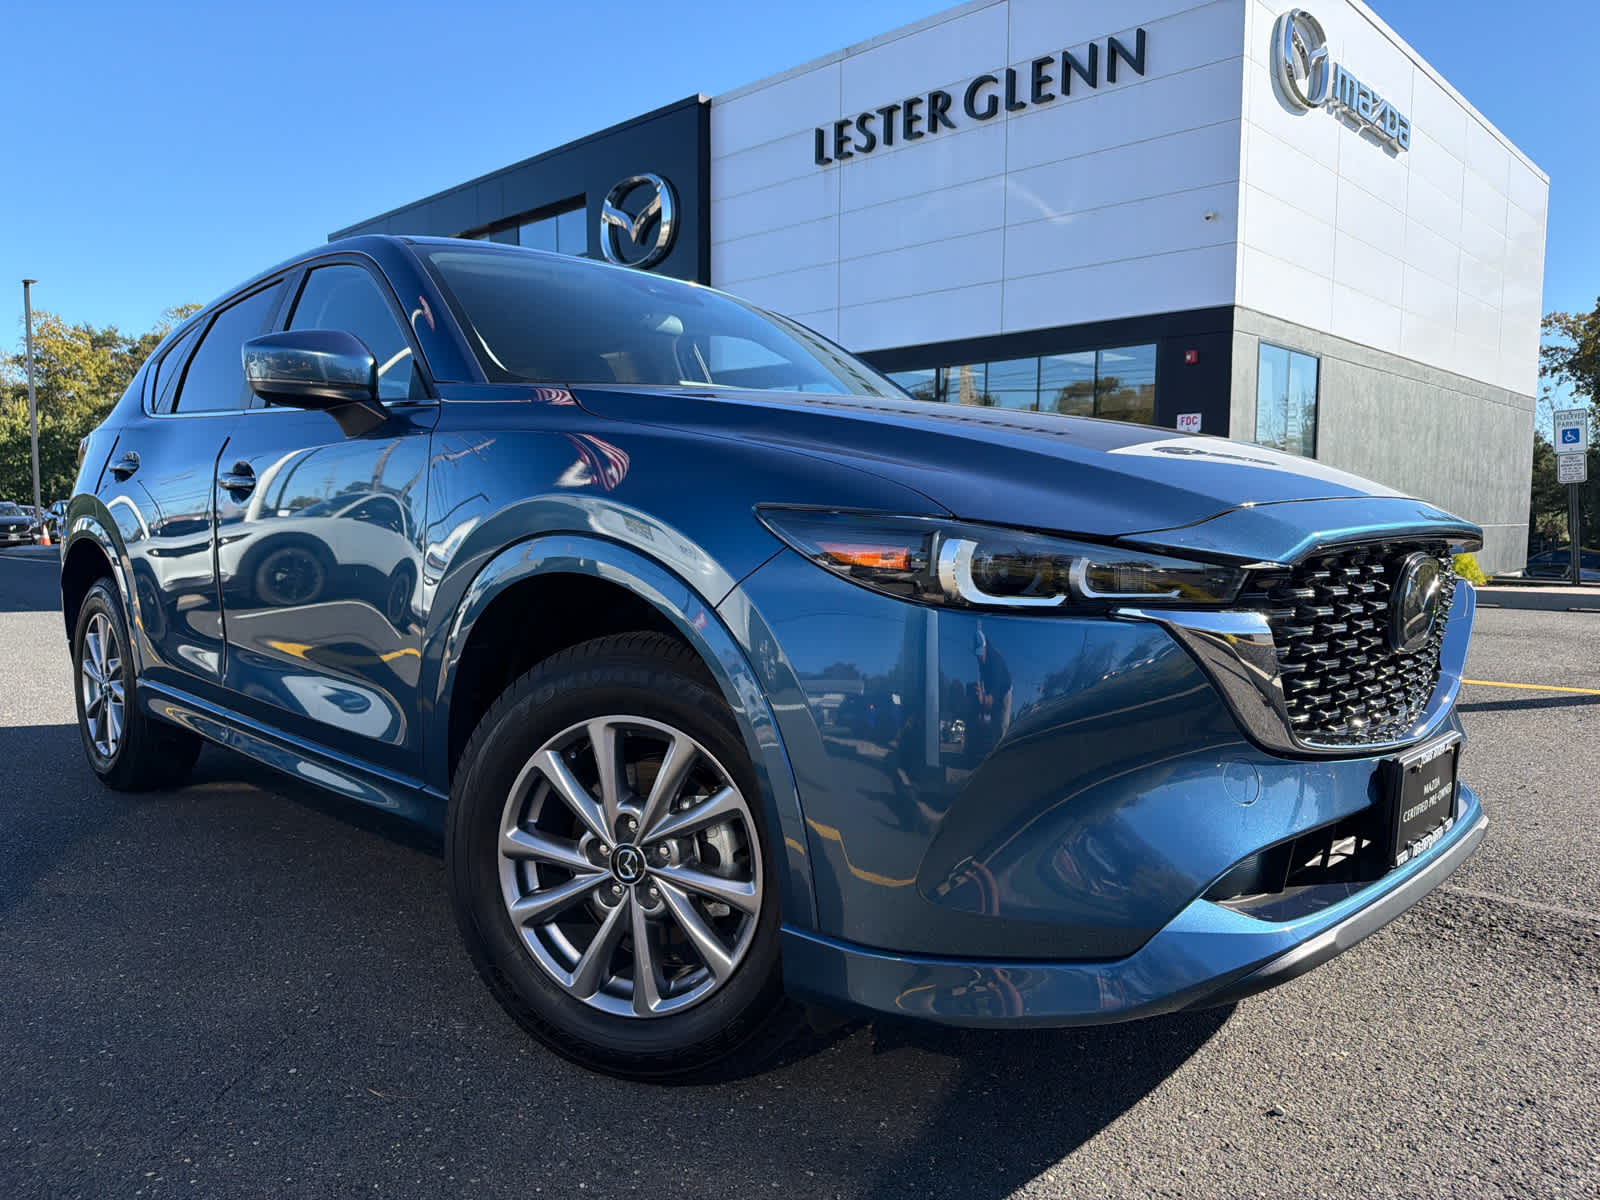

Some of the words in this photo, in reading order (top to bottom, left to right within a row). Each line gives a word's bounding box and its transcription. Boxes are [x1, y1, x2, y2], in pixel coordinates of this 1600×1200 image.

[814, 90, 957, 166] LESTER
[964, 28, 1146, 121] GLENN
[1180, 415, 1198, 425] FDC
[1557, 420, 1585, 428] PARKING
[1423, 776, 1440, 795] MAZDA
[1403, 800, 1429, 822] CERTIFIED
